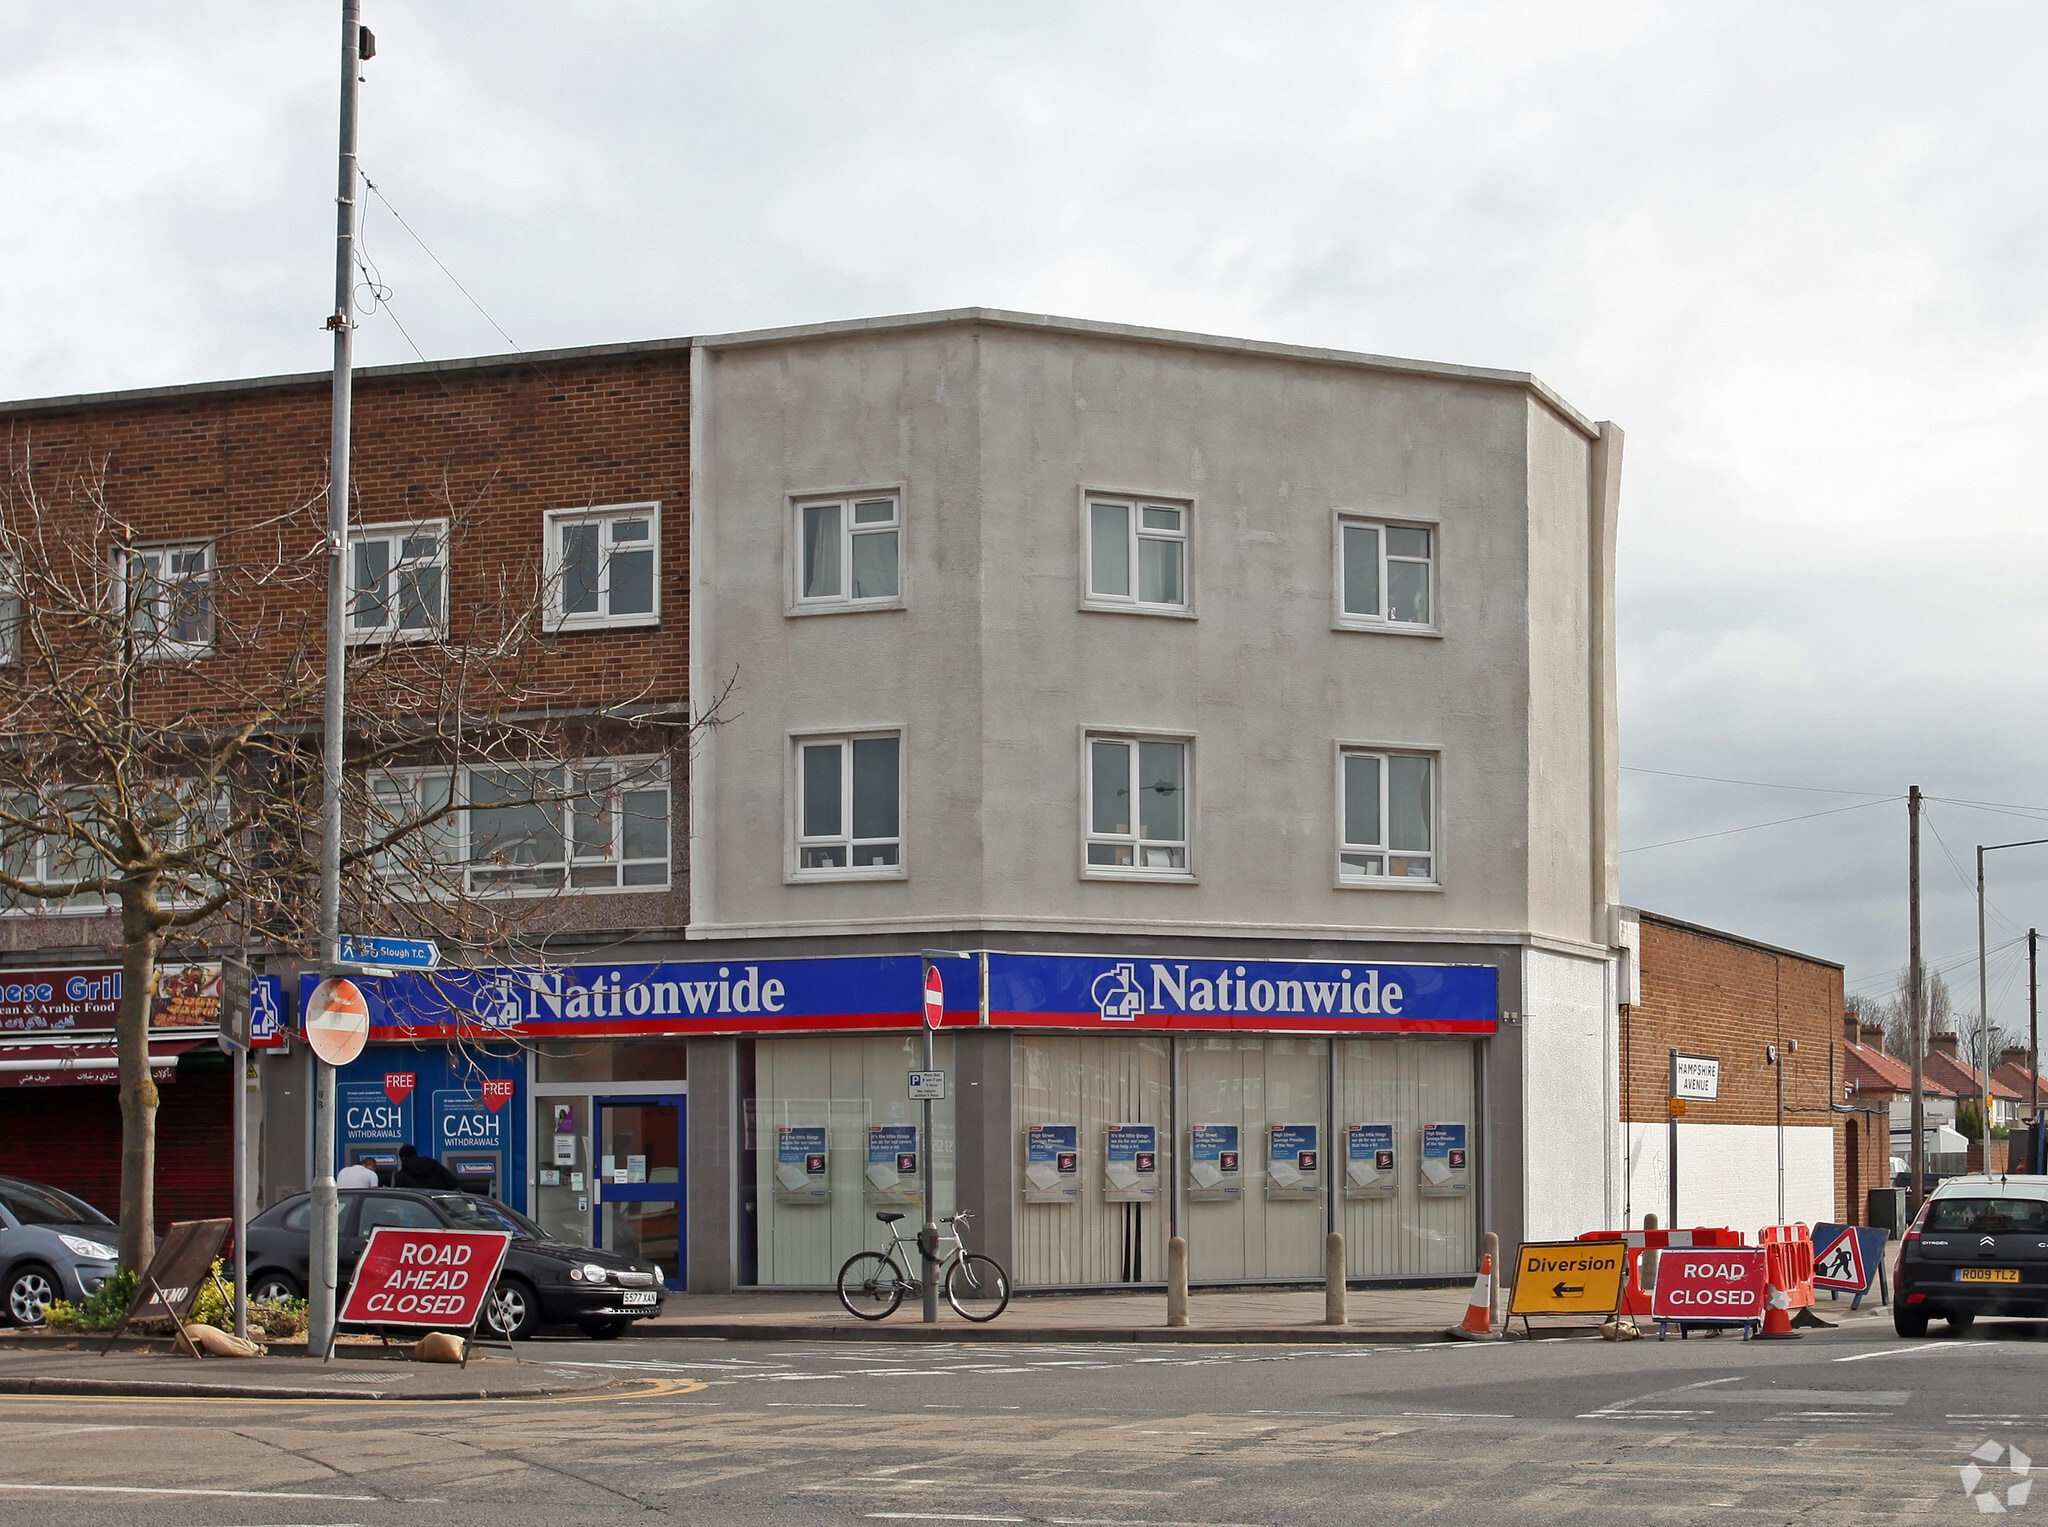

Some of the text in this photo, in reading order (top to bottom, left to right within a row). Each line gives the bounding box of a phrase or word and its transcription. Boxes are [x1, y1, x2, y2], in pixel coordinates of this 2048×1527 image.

[380, 947, 426, 959] Slough T.C.
[66, 972, 122, 1001] Gril
[526, 966, 786, 1019] Nationwide
[1150, 964, 1403, 1015] Nationwide
[24, 1004, 34, 1014] &
[38, 1003, 80, 1014] Arabic
[84, 1002, 116, 1012] Food
[1678, 1062, 1716, 1077] HAMPSHIRE
[386, 1075, 414, 1088] FREE
[483, 1082, 511, 1095] FREE
[1684, 1078, 1708, 1091] AVENUE
[347, 1107, 402, 1128] CASH
[443, 1115, 499, 1136] CASH
[348, 1130, 402, 1138] WITHDRAWALS
[444, 1138, 499, 1146] WITHDRAWALS
[400, 1243, 472, 1266] ROAD
[1527, 1256, 1615, 1273] Diversion
[1684, 1264, 1745, 1278] ROAD
[384, 1270, 469, 1290] AHEAD
[1996, 1270, 2016, 1280] TLZ
[366, 1294, 466, 1315] CLOSED
[1669, 1290, 1756, 1305] CLOSED
